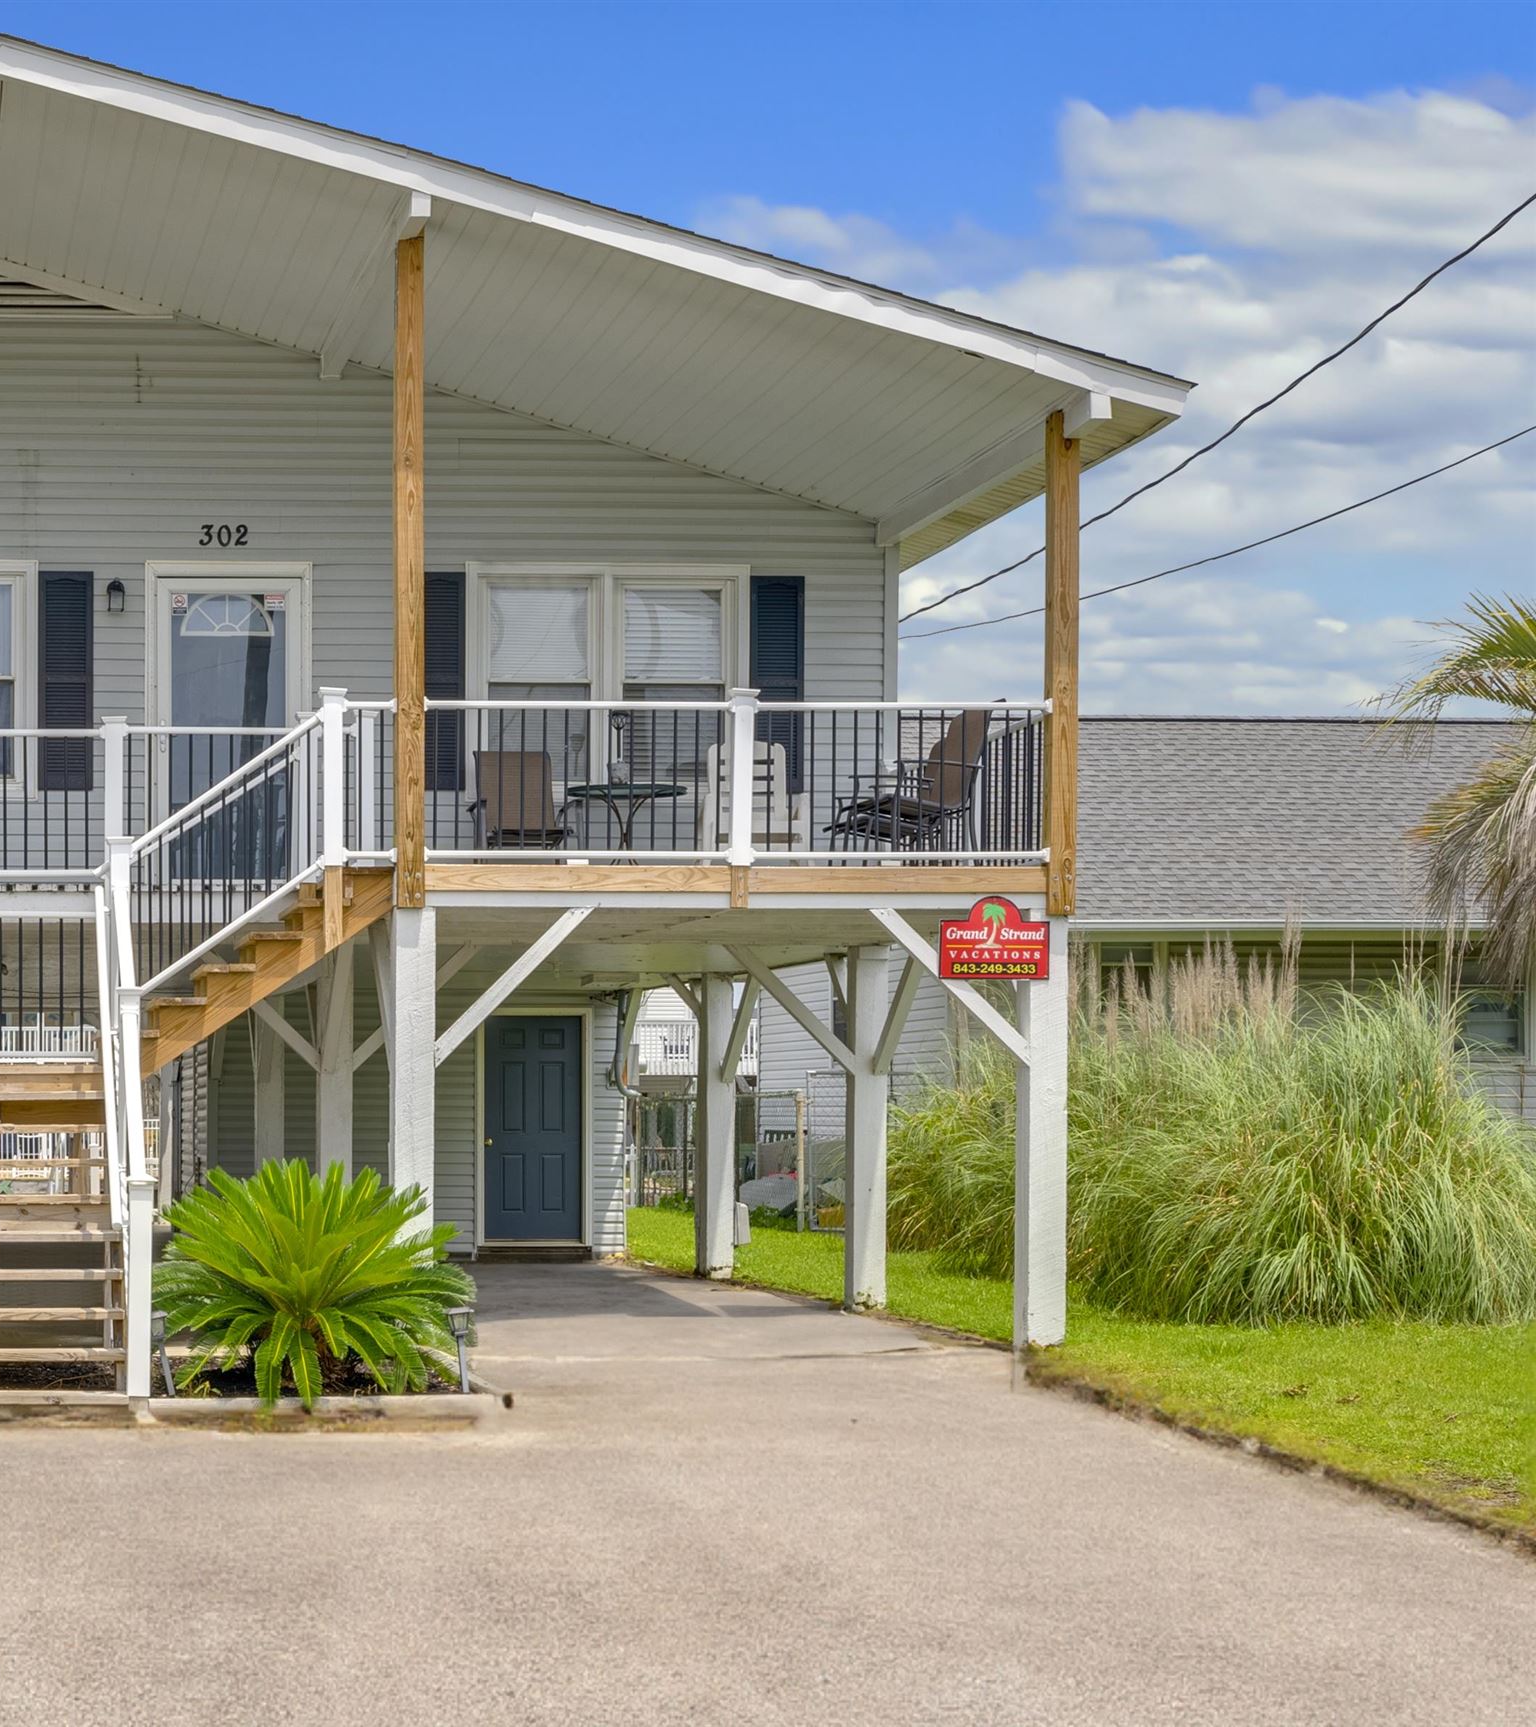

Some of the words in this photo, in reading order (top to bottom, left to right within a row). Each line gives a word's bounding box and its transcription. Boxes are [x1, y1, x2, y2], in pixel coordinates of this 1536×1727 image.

[199, 524, 248, 547] 302
[946, 927, 988, 940] Grand
[1000, 927, 1045, 940] Strand
[949, 950, 1041, 959] VACATIONS
[953, 963, 1036, 974] 843-249-3433
